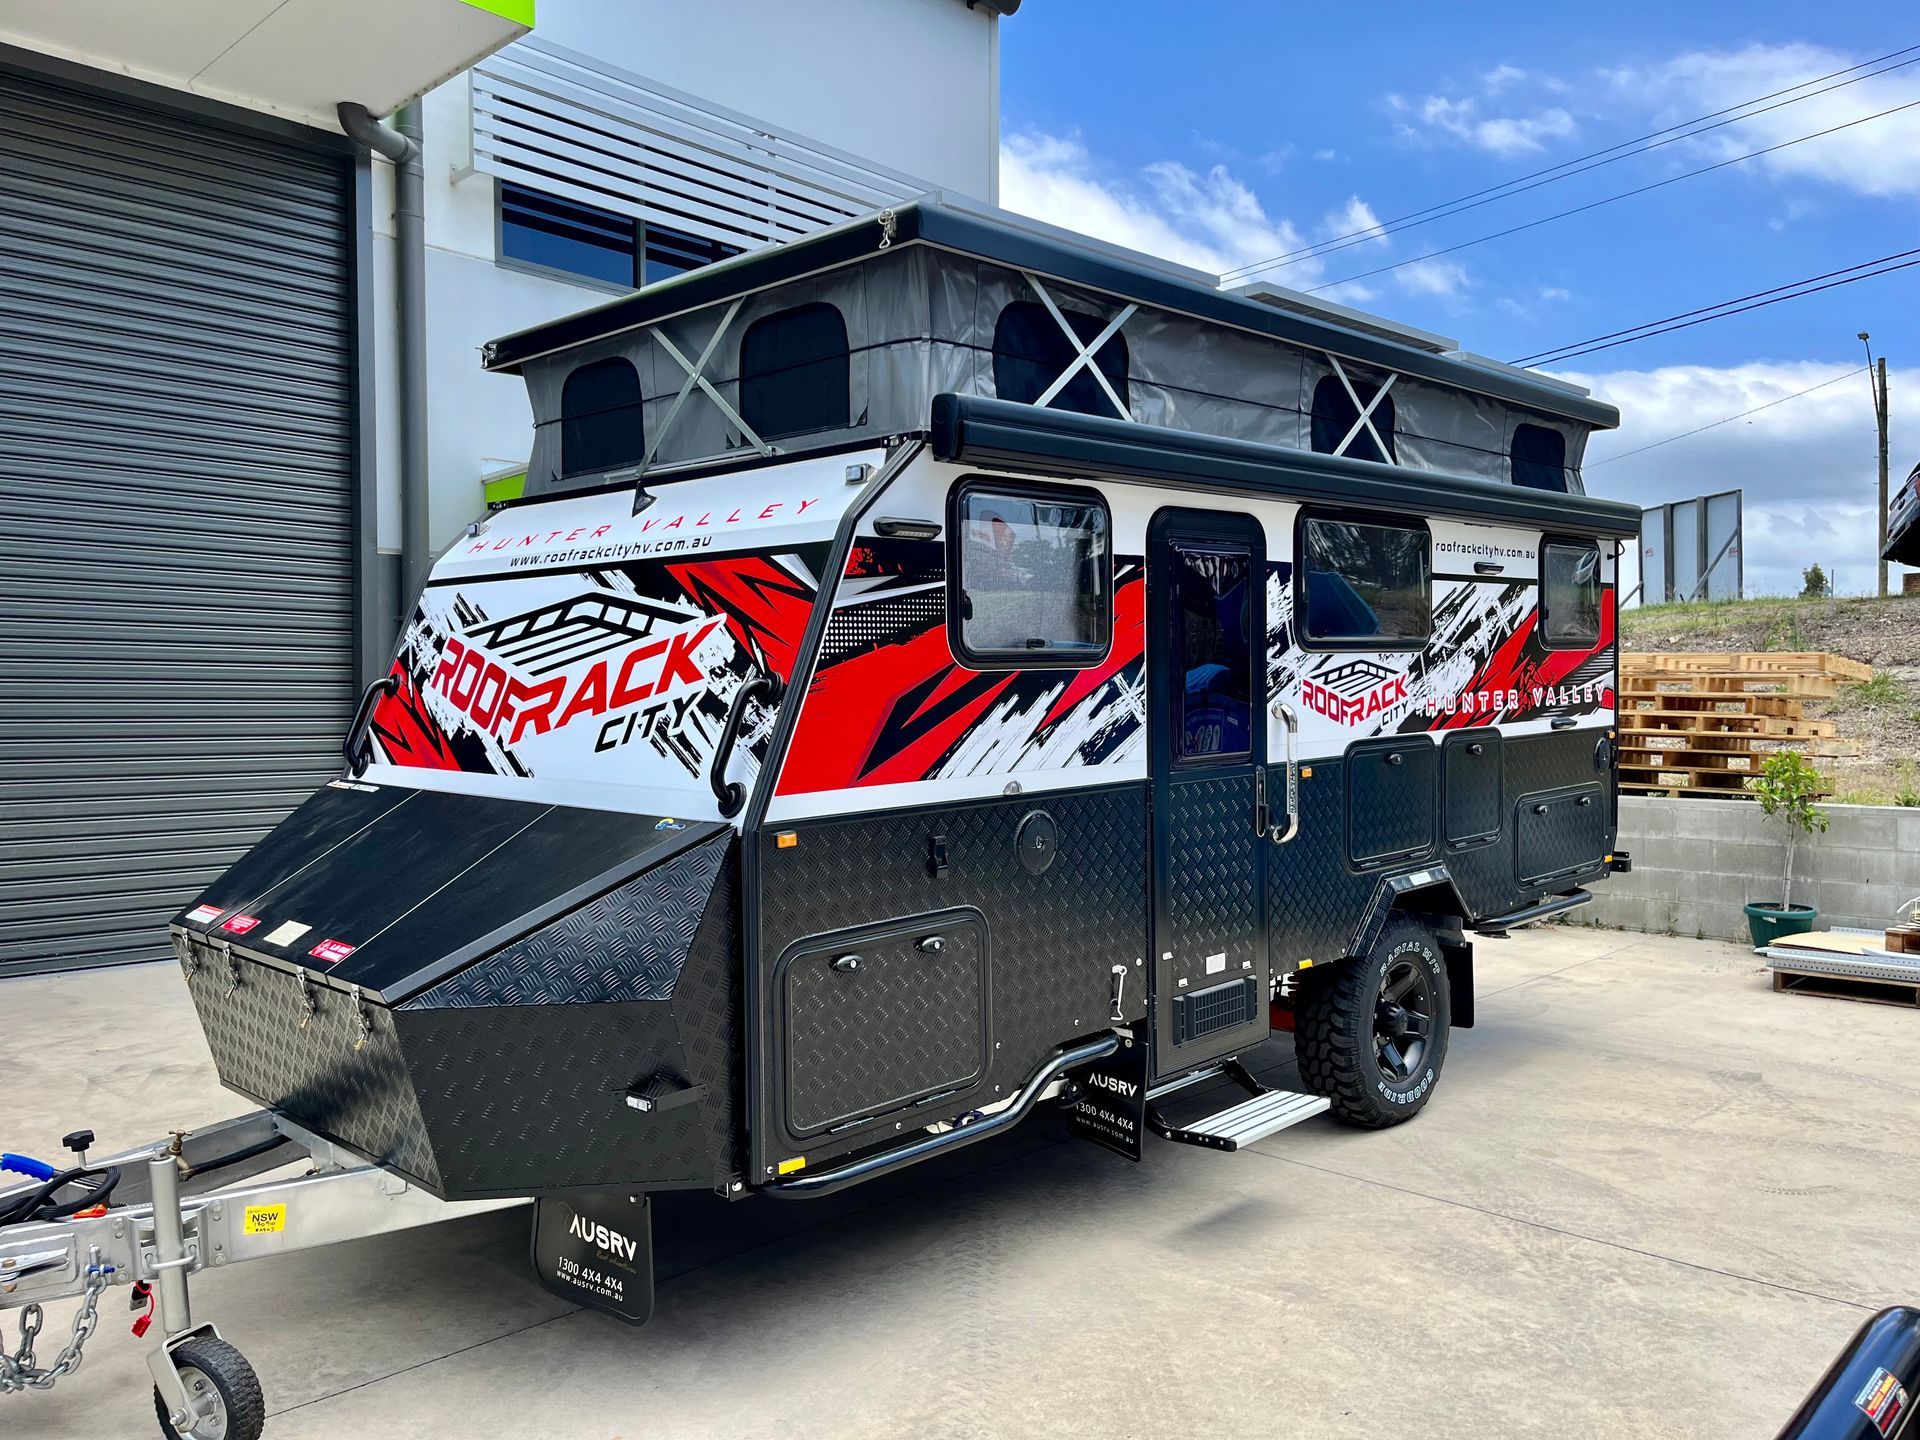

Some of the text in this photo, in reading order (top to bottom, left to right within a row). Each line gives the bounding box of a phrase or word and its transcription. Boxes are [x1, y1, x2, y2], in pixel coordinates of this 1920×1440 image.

[467, 498, 819, 554] HUNTER VALLEY
[509, 535, 713, 567] www.roofrackcityhv.com.au
[1435, 541, 1536, 559] roofrackcityhv.com.au
[431, 622, 718, 745] ROOFRACK
[1302, 674, 1408, 728] ROOFRACK
[1382, 700, 1408, 727] CITY
[1426, 684, 1605, 717] HUNTER VALLEY
[595, 692, 697, 752] CITY
[1379, 941, 1420, 977] RADIAL
[1088, 1072, 1138, 1098] AUSRV
[1076, 1102, 1097, 1116] 1300
[252, 1212, 278, 1222] NSW
[569, 1213, 637, 1262] AUSRV
[556, 1270, 623, 1302] www.ausrv.com.au
[558, 1256, 579, 1276] 1300
[582, 1267, 602, 1284] 4X4
[604, 1275, 624, 1293] 4X4
